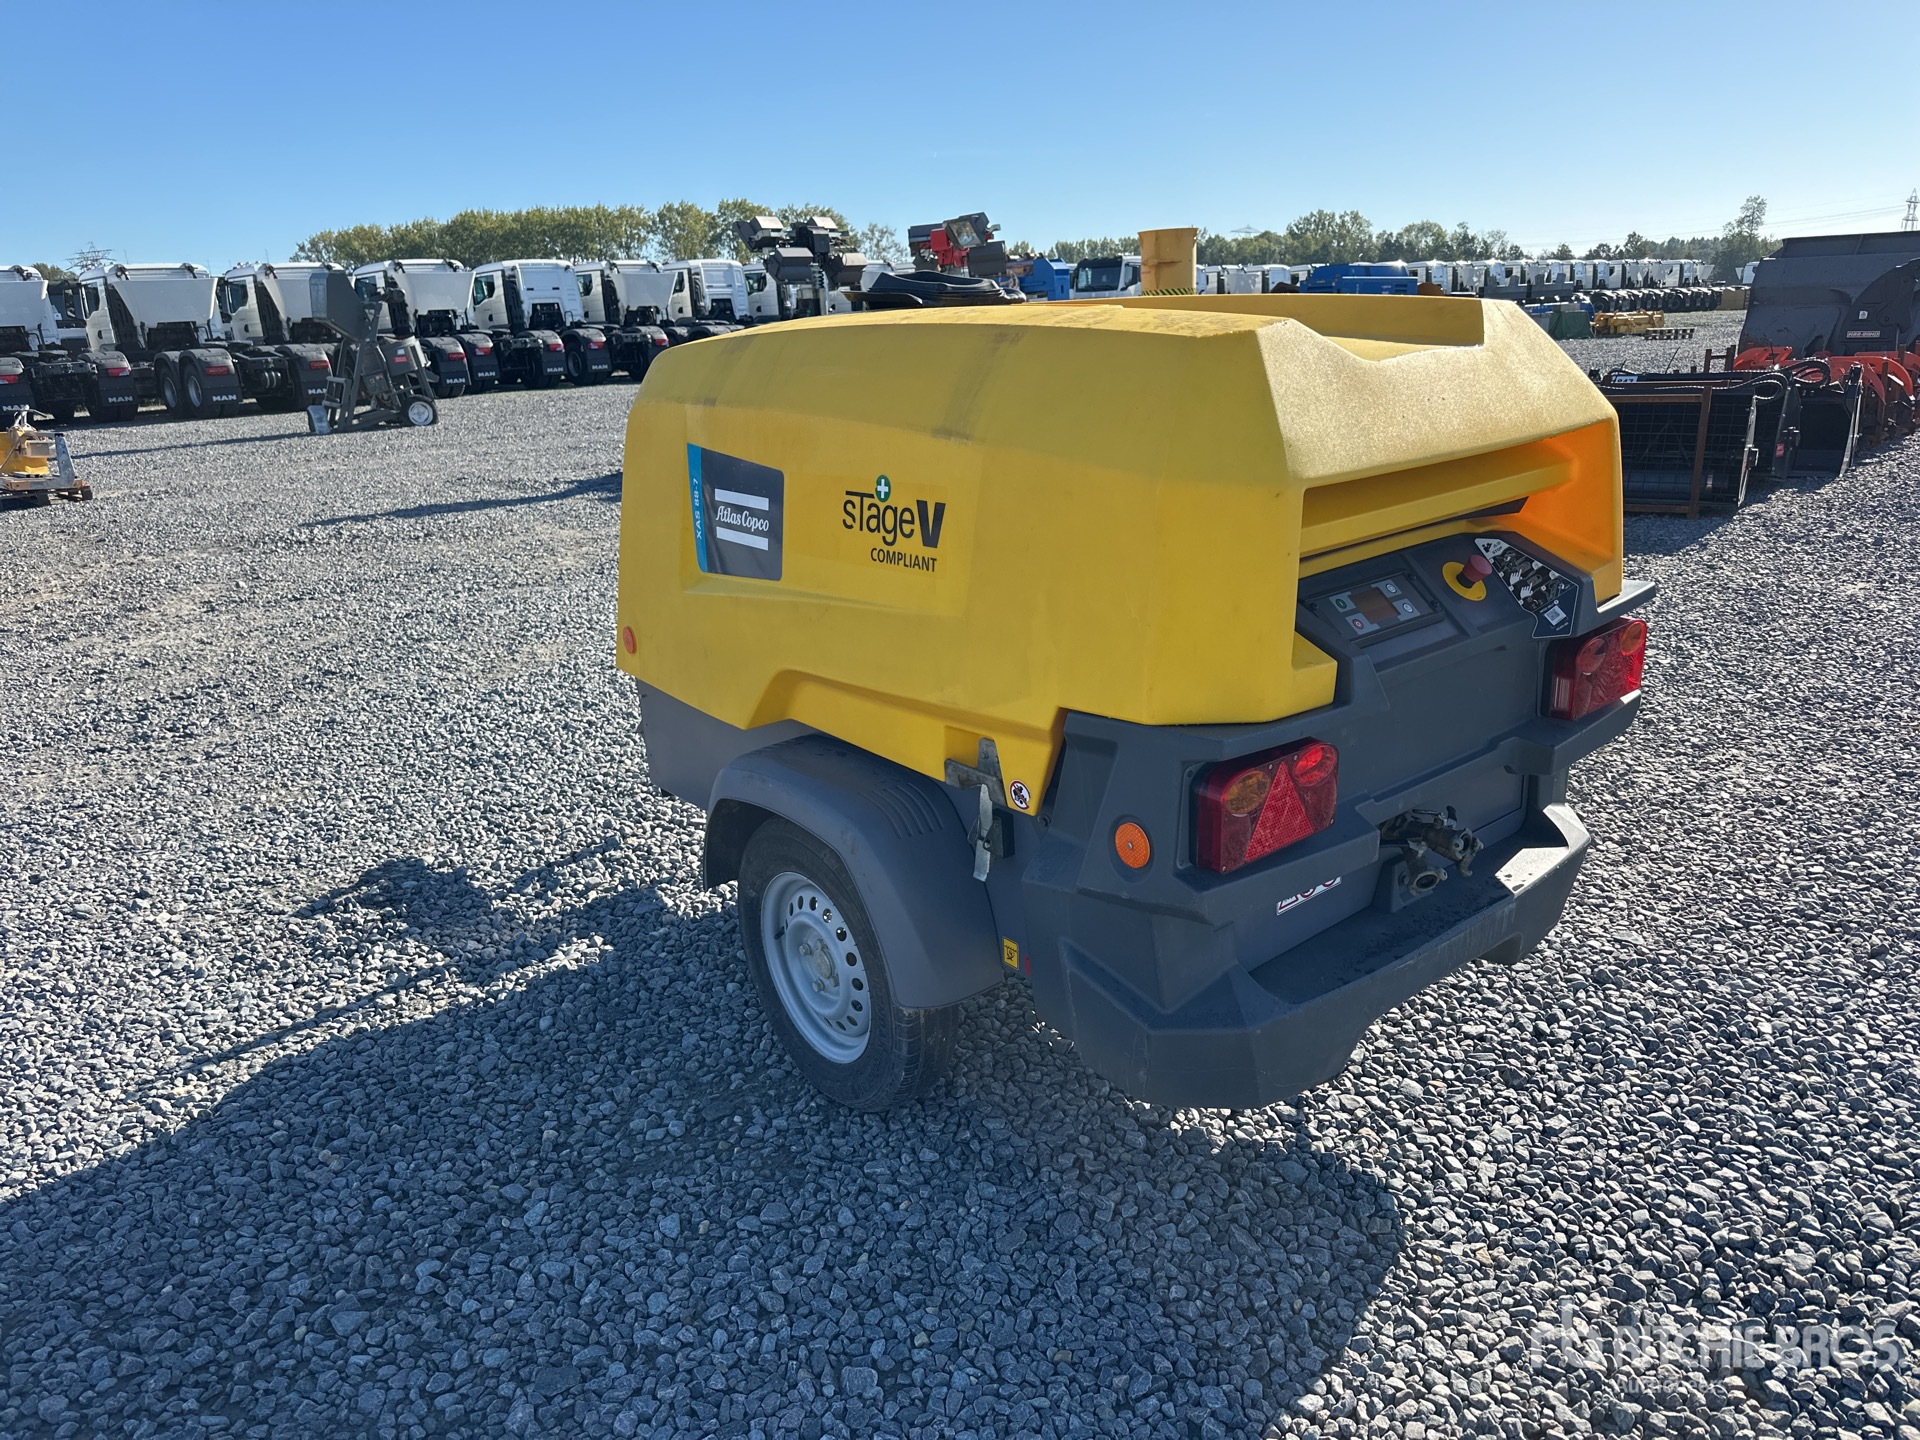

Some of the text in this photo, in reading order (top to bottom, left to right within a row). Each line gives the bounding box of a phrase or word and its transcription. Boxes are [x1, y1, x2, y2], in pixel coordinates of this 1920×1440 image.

[592, 363, 609, 371] MAN
[477, 370, 496, 378] MAN
[108, 395, 134, 403] MAN
[212, 394, 237, 402] MAN
[715, 505, 769, 532] Atlas Copco
[870, 547, 937, 572] COMPLIANT
